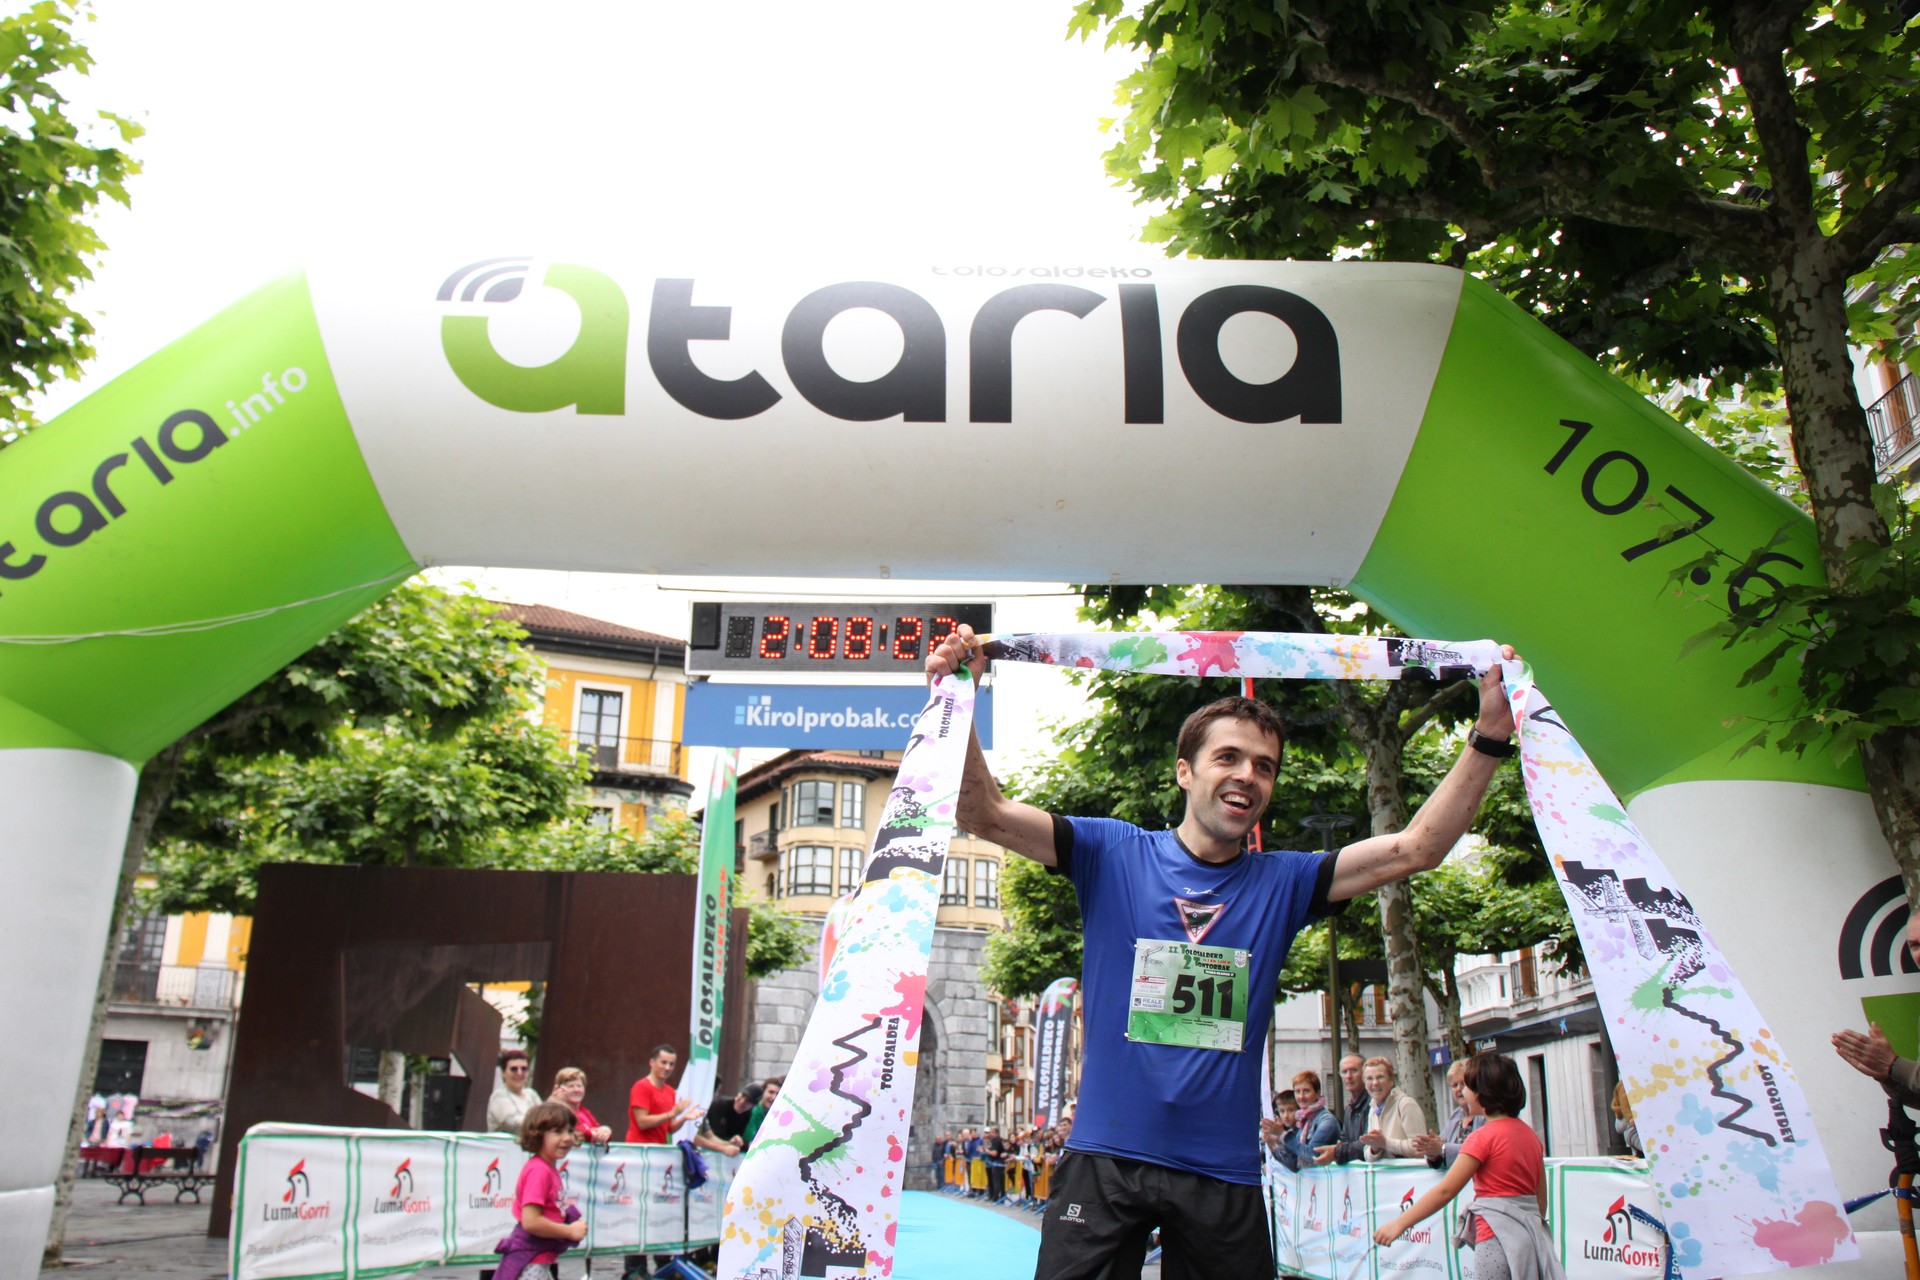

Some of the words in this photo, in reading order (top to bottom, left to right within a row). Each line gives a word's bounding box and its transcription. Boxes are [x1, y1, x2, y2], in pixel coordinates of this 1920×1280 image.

[931, 265, 1153, 279] tolosaldeko
[437, 257, 1342, 424] ataria
[0, 365, 309, 580] taria.info
[746, 695, 920, 733] Kirolprobak.co
[1172, 974, 1233, 1018] 511
[881, 1017, 900, 1090] TOLOSALDEA
[1038, 1020, 1055, 1109] TOLOSALDEKO
[263, 1201, 330, 1221] LumaGorri
[373, 1196, 431, 1214] LumaGorri
[1583, 1240, 1661, 1268] LumaGorri
